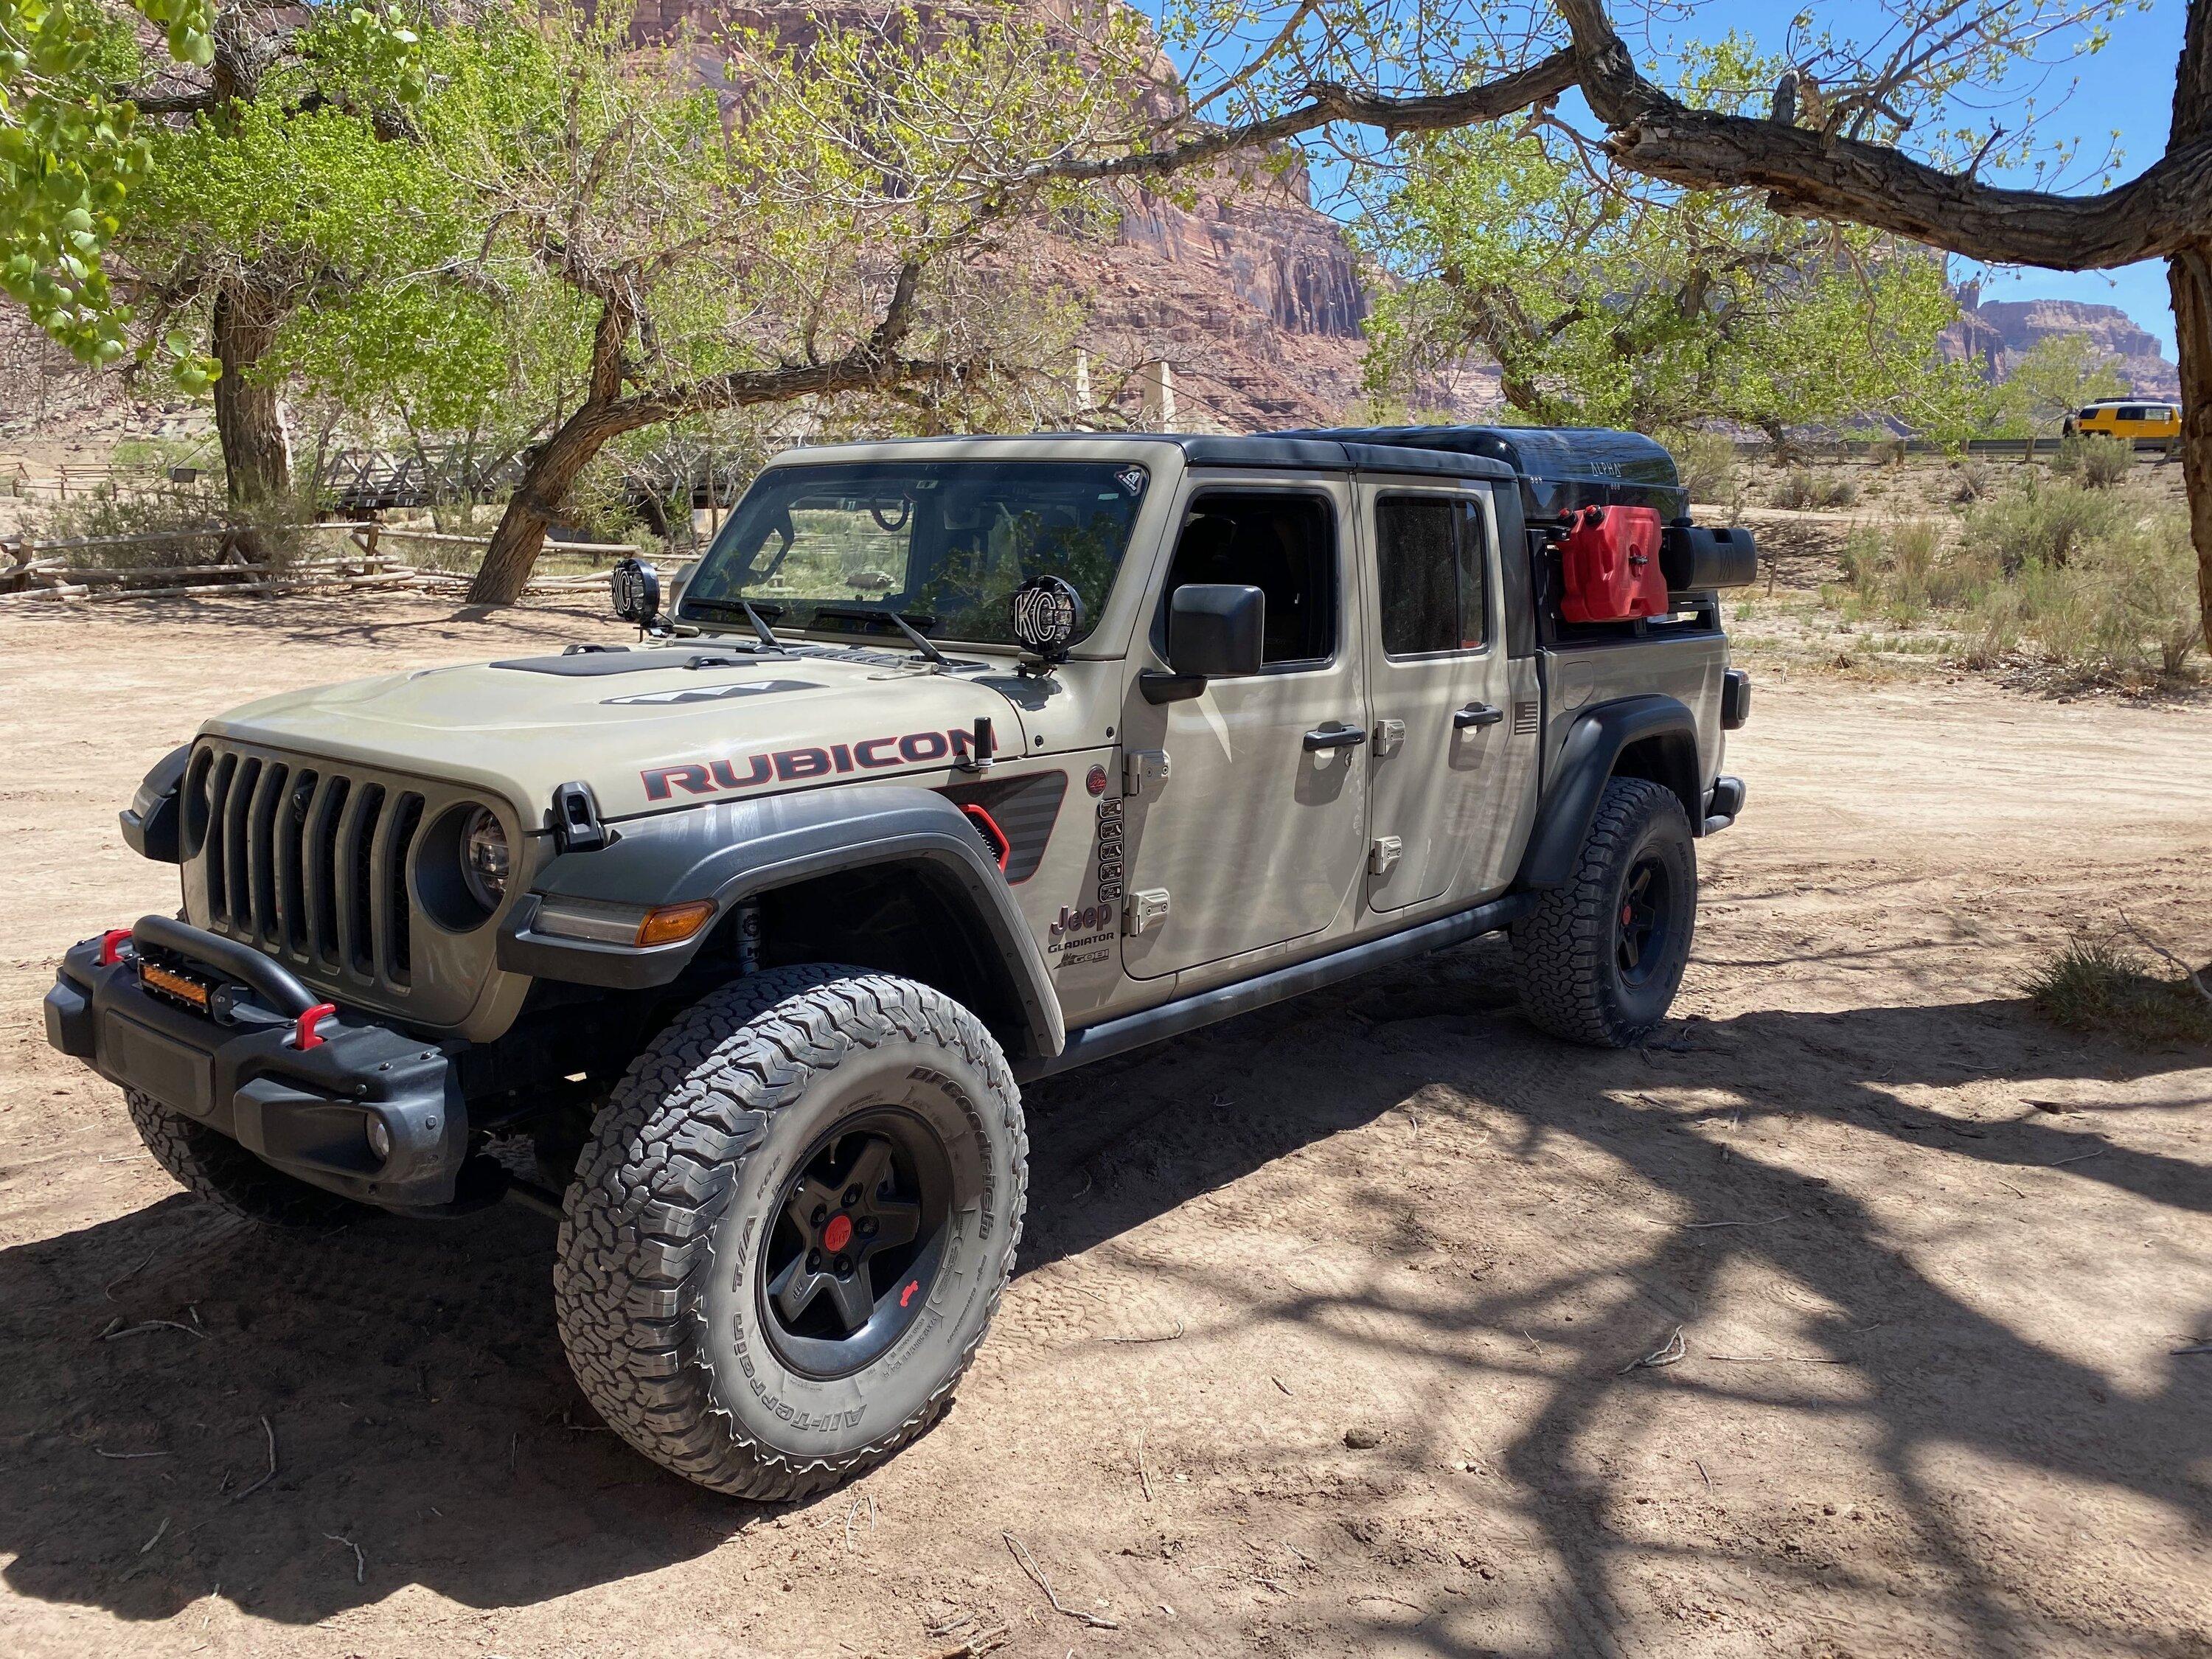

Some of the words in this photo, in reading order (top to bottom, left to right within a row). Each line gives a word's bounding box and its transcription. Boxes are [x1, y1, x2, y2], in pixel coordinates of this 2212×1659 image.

[1590, 462, 1621, 477] ALPHA
[611, 567, 630, 615] KC
[1015, 587, 1056, 644] KC
[640, 728, 998, 801] RUBICON
[1048, 932, 1114, 953] GLADIATOR
[1050, 904, 1112, 936] Jeep
[1074, 948, 1109, 964] GOBI
[905, 1065, 996, 1240] BFGoodrich
[732, 1216, 757, 1293] T/A
[732, 1312, 867, 1432] All-Terrain
